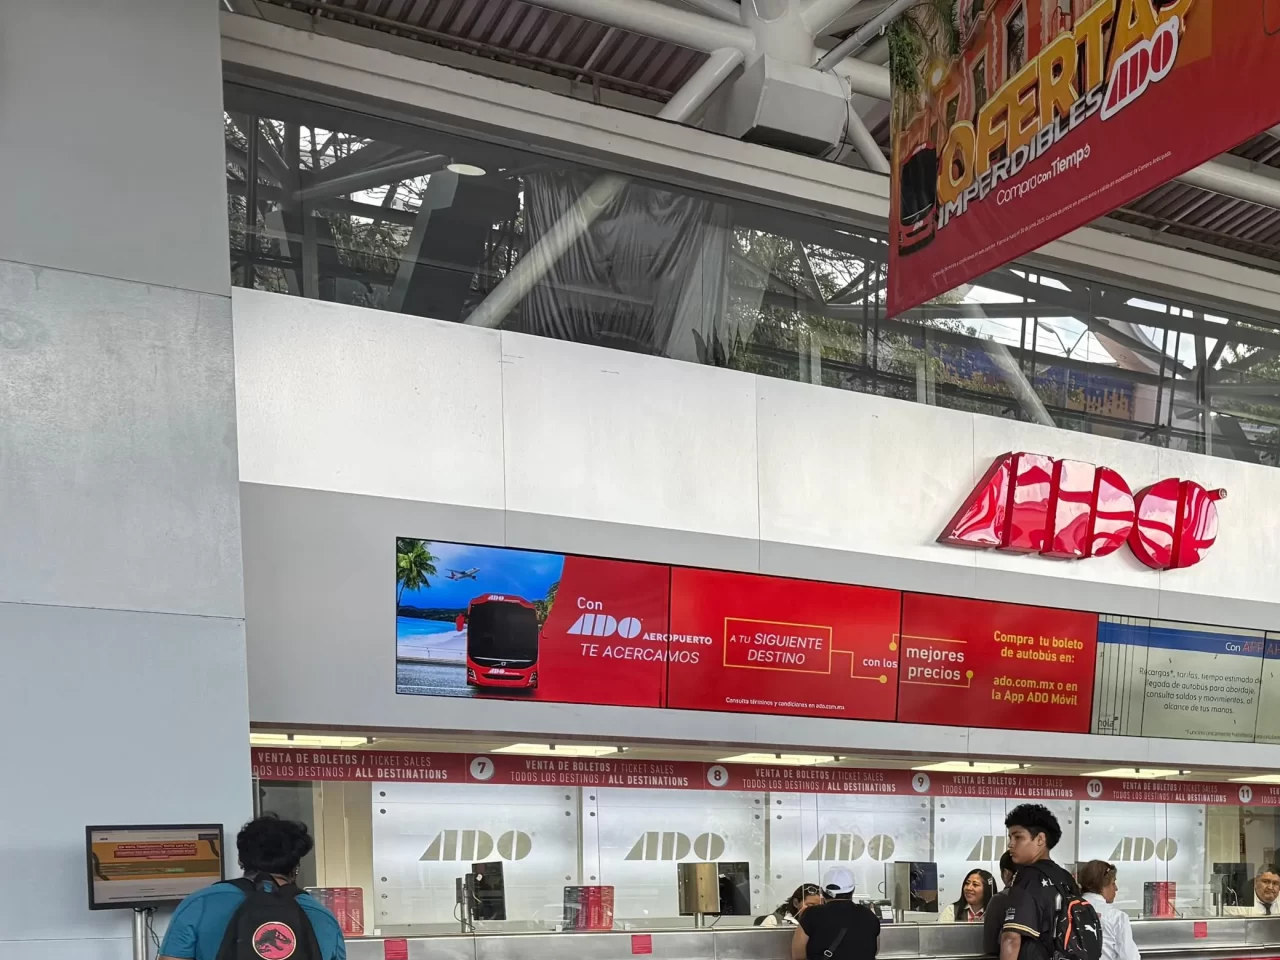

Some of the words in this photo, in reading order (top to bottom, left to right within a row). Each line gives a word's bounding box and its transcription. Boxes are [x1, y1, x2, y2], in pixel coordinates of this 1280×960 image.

[1102, 18, 1178, 119] ADO
[937, 92, 1103, 230] IMPERDIBLES
[936, 451, 1220, 570] ADO
[577, 597, 603, 610] Con
[566, 613, 642, 638] ADO
[642, 633, 713, 645] AEROPUERTO
[739, 635, 751, 643] TU
[754, 633, 823, 649] SIGUIENTE
[994, 630, 1034, 645] Compra
[1039, 635, 1049, 646] tu
[1052, 636, 1083, 650] boleto
[1226, 642, 1240, 652] Con
[580, 643, 599, 656] TE
[602, 645, 700, 663] ACERCAMOS
[747, 649, 805, 664] DESTINO
[906, 647, 964, 662] mejores
[1001, 647, 1014, 657] de
[1016, 648, 1057, 661] autobús
[1060, 653, 1075, 663] en:
[862, 658, 880, 667] con
[883, 658, 898, 668] los
[908, 666, 961, 680] precios
[993, 676, 1054, 690] ado.com.mx
[1057, 682, 1063, 690] o
[1066, 682, 1078, 691] en
[992, 689, 1001, 699] la
[1004, 690, 1024, 703] App
[1027, 692, 1048, 703] ADO
[1051, 693, 1078, 706] Móvil
[258, 752, 291, 763] VENTA
[296, 753, 309, 764] DE
[313, 754, 358, 765] BOLETOS
[369, 755, 400, 766] TICKET
[404, 756, 431, 767] SALES
[276, 765, 294, 776] LOS
[298, 767, 344, 777] DESTINOS
[355, 768, 373, 778] ALL
[378, 769, 448, 780] DESTINATIONS
[477, 762, 486, 774] 7
[526, 760, 555, 771] VENTA
[558, 761, 569, 771] DE
[572, 761, 611, 772] BOLETOS
[621, 763, 647, 773] TICKET
[650, 764, 674, 775] SALES
[714, 770, 721, 780] 8
[756, 769, 780, 778] VENTA
[784, 769, 792, 778] DE
[796, 770, 829, 779] BOLETOS
[838, 771, 861, 780] TICKET
[863, 772, 884, 781] SALES
[510, 771, 537, 782] TODOS
[541, 772, 556, 783] LOS
[559, 773, 599, 784] DESTINOS
[608, 775, 624, 785] ALL
[627, 775, 689, 786] DESTINATIONS
[742, 779, 766, 789] TODOS
[769, 780, 782, 789] LOS
[785, 780, 819, 790] DESTINOS
[827, 782, 841, 791] ALL
[844, 783, 896, 792] DESTINATIONS
[918, 778, 924, 787] 9
[953, 775, 974, 784] VENTA
[977, 776, 985, 784] DE
[988, 777, 1017, 785] BOLETOS
[942, 785, 962, 794] TODOS
[965, 786, 976, 794] LOS
[978, 786, 1008, 795] DESTINOS
[1014, 788, 1026, 796] ALL
[1029, 789, 1073, 797] DESTINATIONS
[1089, 783, 1100, 792] 10
[1241, 789, 1250, 798] 11
[1175, 793, 1186, 801] ALL
[1188, 794, 1227, 802] DESTINATIONS
[418, 829, 532, 861] ADO
[623, 831, 726, 861] ADO
[806, 833, 895, 861] ADO
[1108, 836, 1178, 862] ADO
